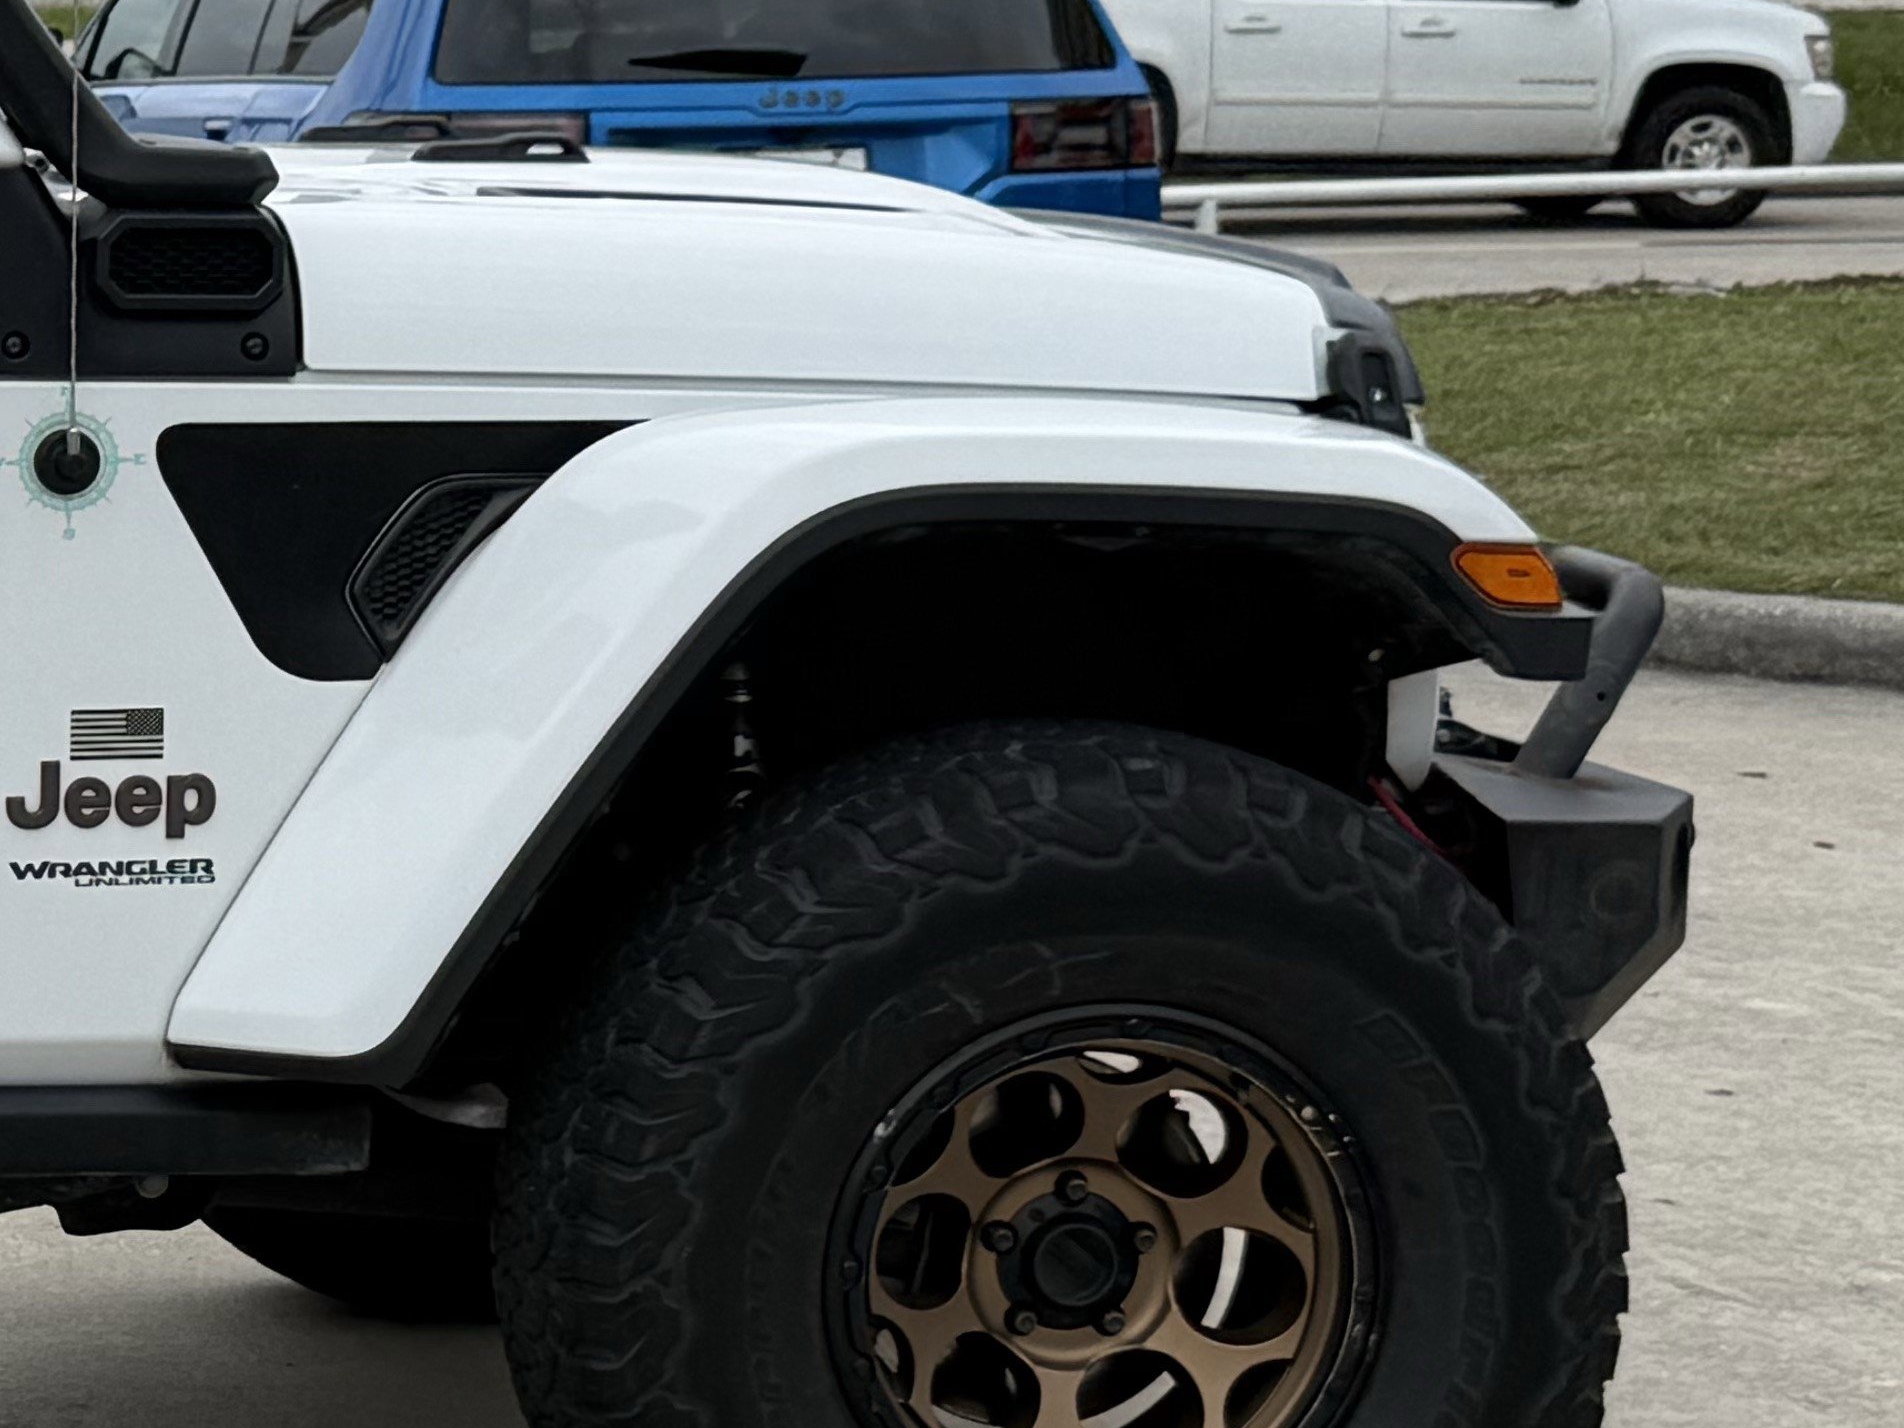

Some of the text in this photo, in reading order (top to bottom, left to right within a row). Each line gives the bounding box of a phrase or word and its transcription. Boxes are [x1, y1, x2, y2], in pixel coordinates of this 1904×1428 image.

[5, 759, 217, 839] Jeep
[9, 857, 214, 880] WRANGLER
[74, 874, 216, 887] UNLIMITED
